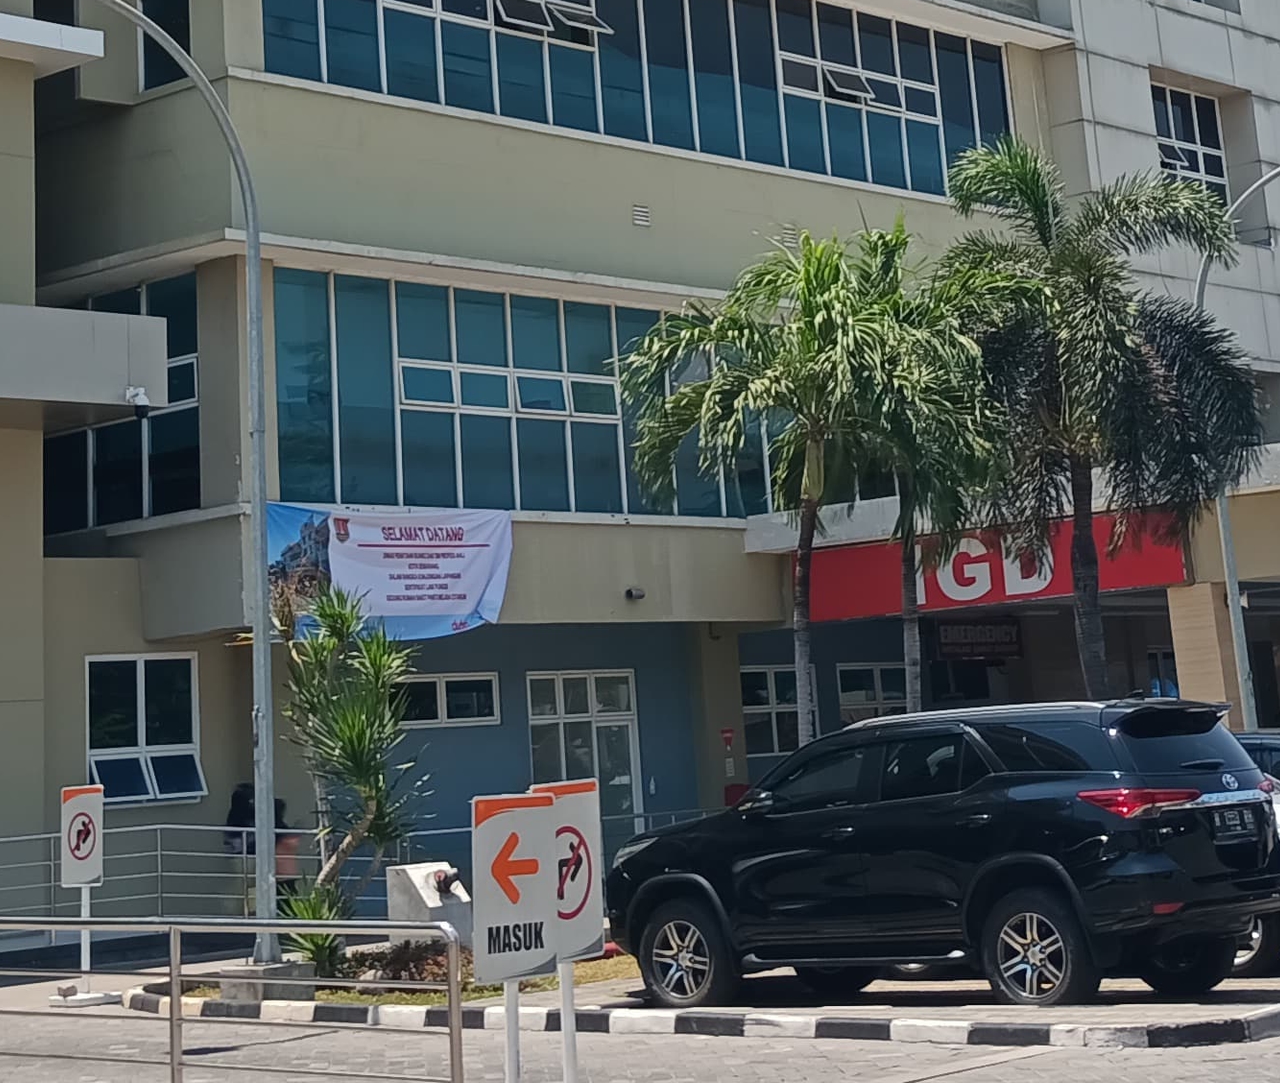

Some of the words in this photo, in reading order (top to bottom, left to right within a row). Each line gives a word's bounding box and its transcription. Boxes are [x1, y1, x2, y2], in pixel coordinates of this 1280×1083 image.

[381, 526, 425, 541] SELAMAT
[425, 526, 465, 542] DATANG
[915, 530, 1054, 605] IGD
[487, 921, 545, 955] MASUK
